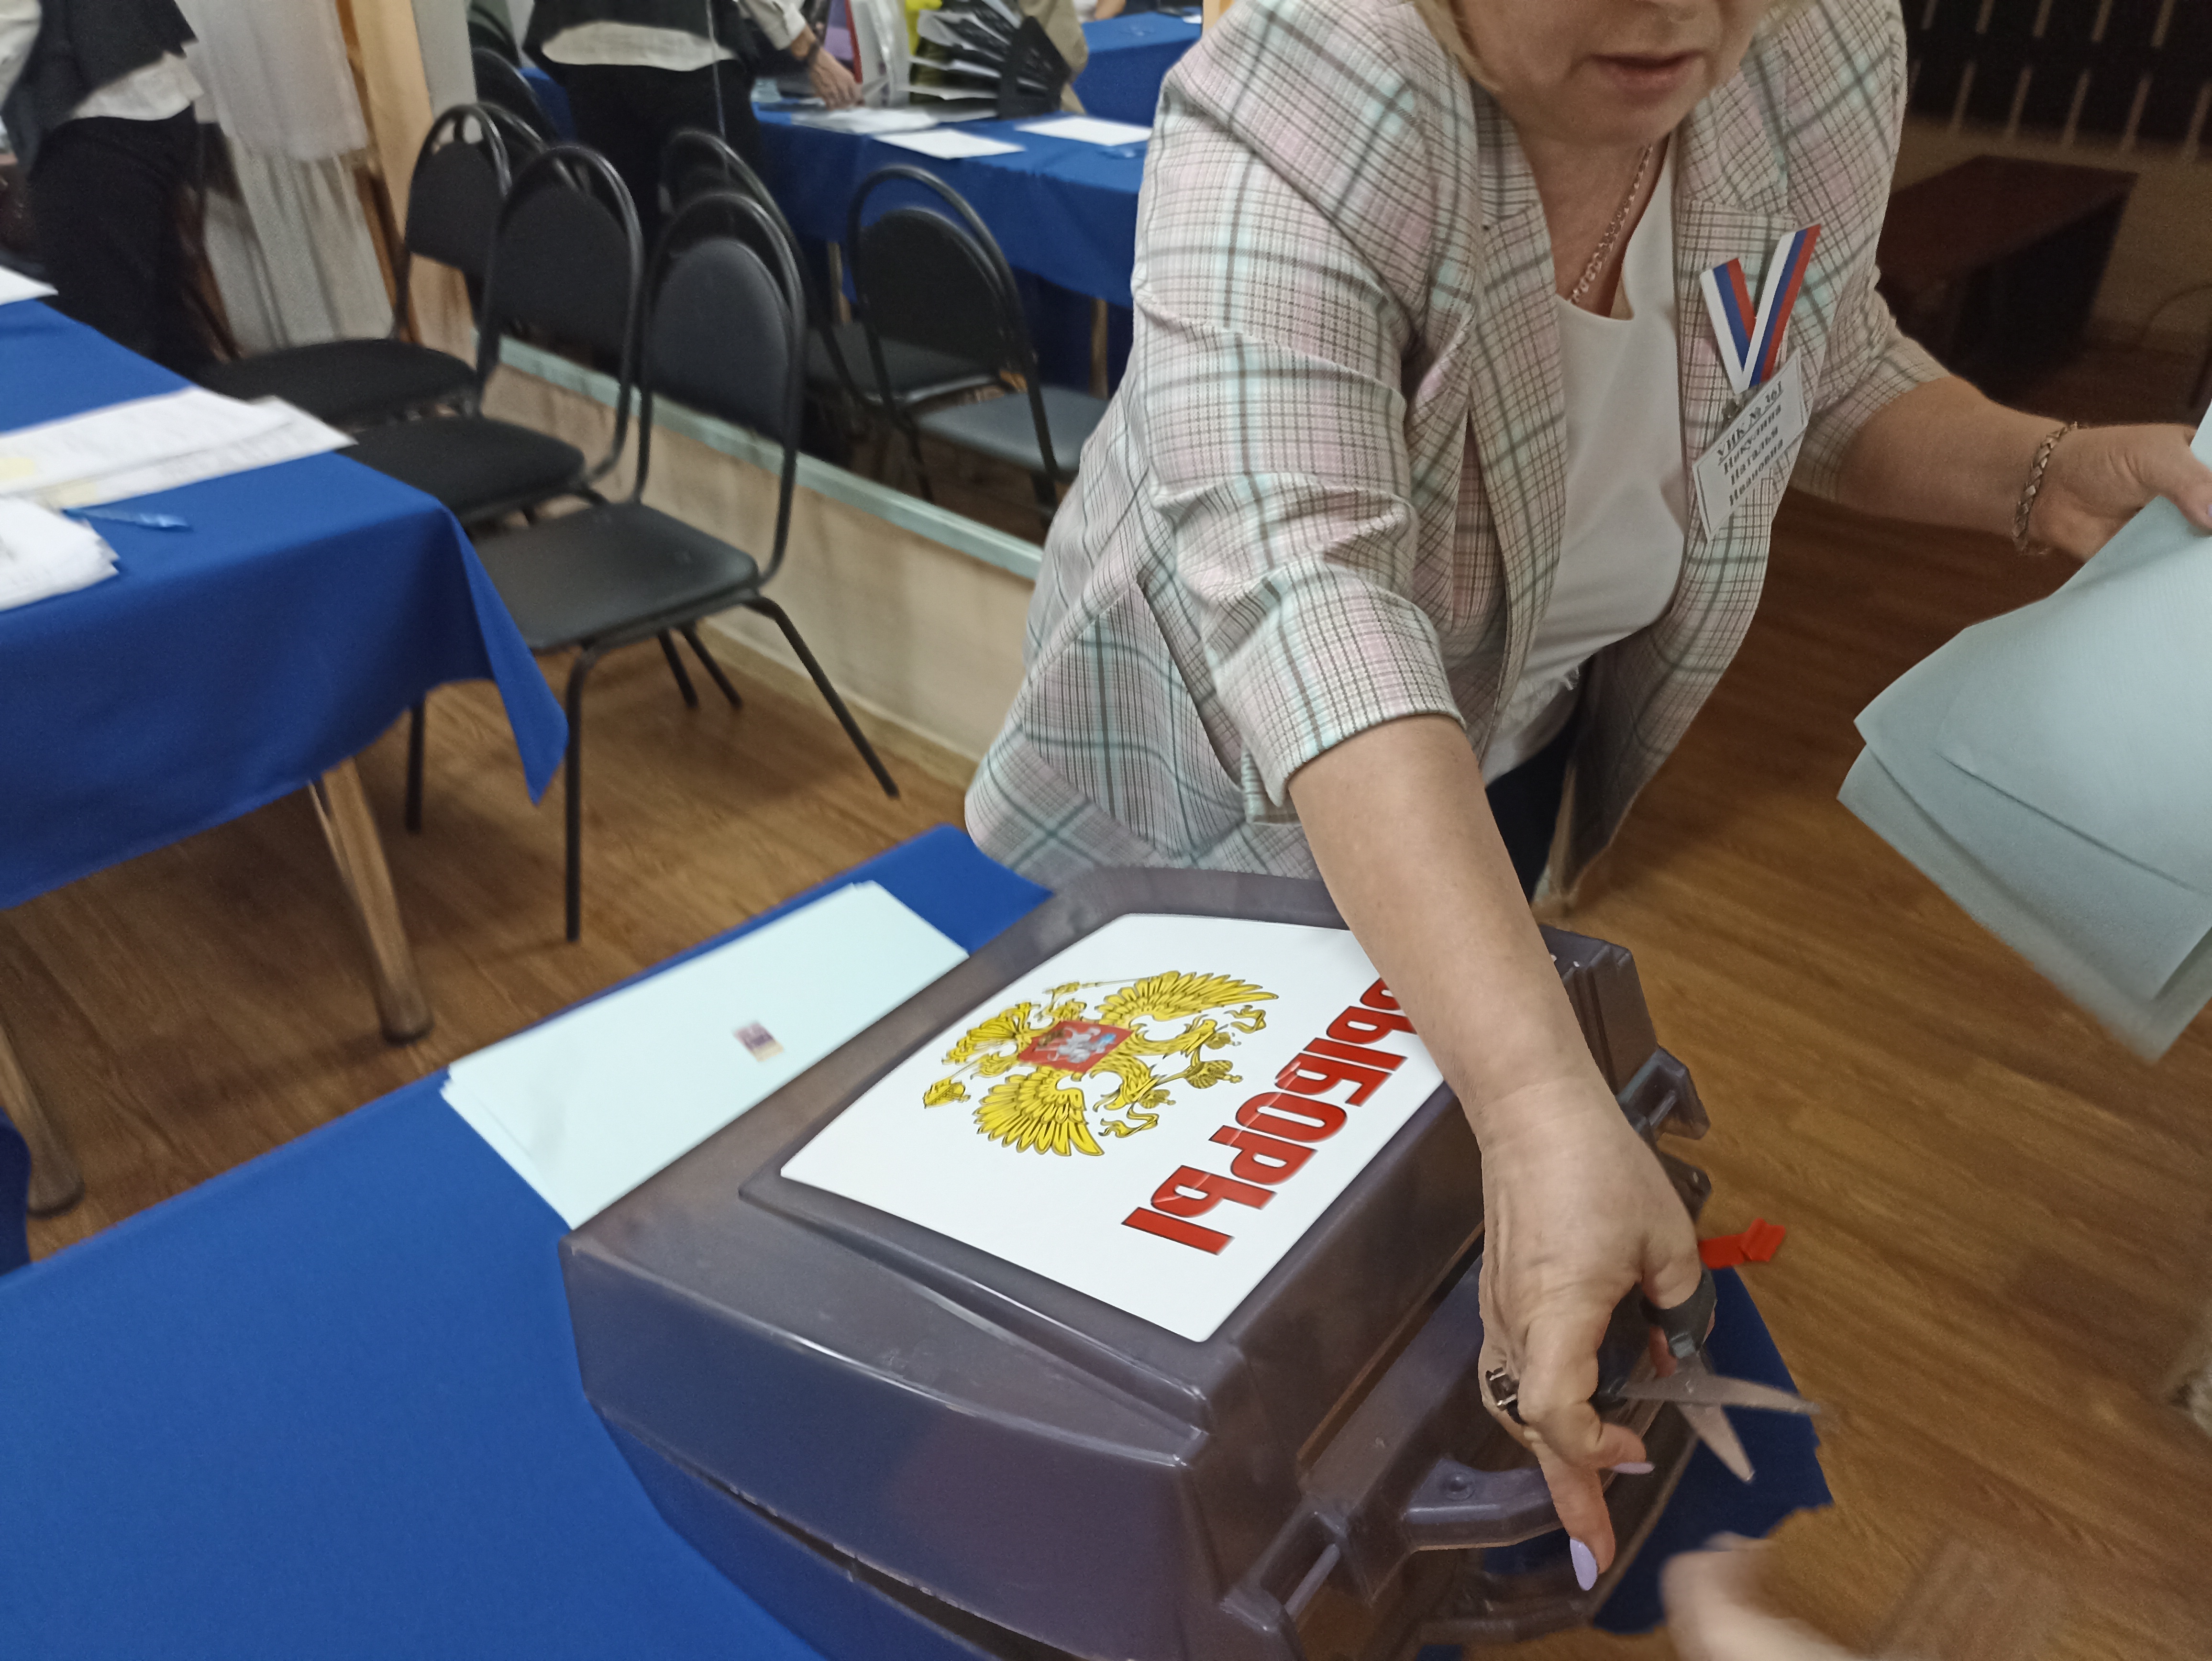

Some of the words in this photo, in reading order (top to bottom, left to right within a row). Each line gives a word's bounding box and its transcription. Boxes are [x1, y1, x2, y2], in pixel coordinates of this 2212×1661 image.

[1717, 422, 1745, 463] УИК
[1748, 407, 1761, 429] №
[1731, 426, 1778, 486] Наталья
[1729, 438, 1783, 507] Ивановна
